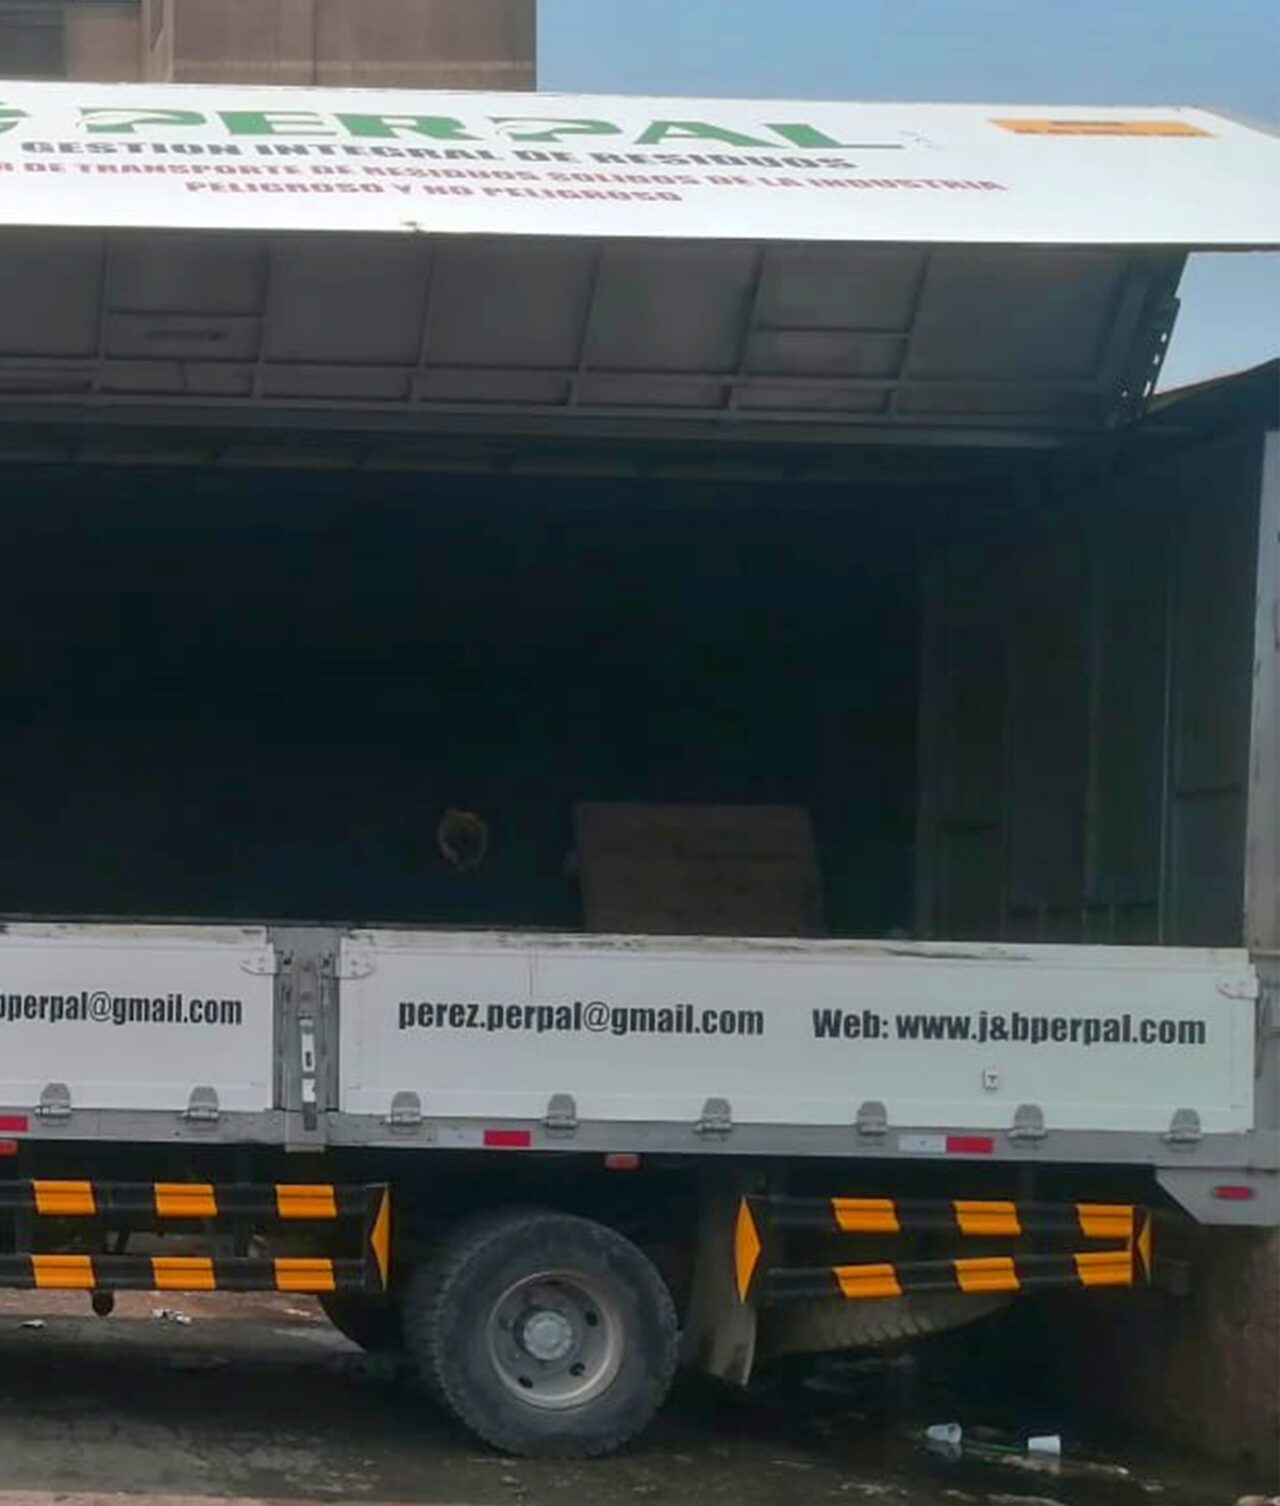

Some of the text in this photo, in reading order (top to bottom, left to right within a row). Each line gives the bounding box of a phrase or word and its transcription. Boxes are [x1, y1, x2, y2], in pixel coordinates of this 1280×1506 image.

[76, 108, 905, 149] PERPAL
[21, 141, 857, 169] GESTION INTEGRAL DE RESIDUOS
[23, 162, 65, 173] DE
[79, 163, 302, 176] TRANSPORTE
[310, 166, 354, 175] DE
[362, 166, 540, 181] RESIDUOS
[547, 172, 700, 185] SOLIDOS
[757, 177, 804, 188] LA
[808, 178, 1007, 192] INDUSTRIA
[186, 181, 683, 201] PELIGROSO Y NO PELIGROSO
[398, 1001, 764, 1036] perez.perpal@gmail.com
[813, 1009, 1206, 1045] Web: www.j&bperpal.com
